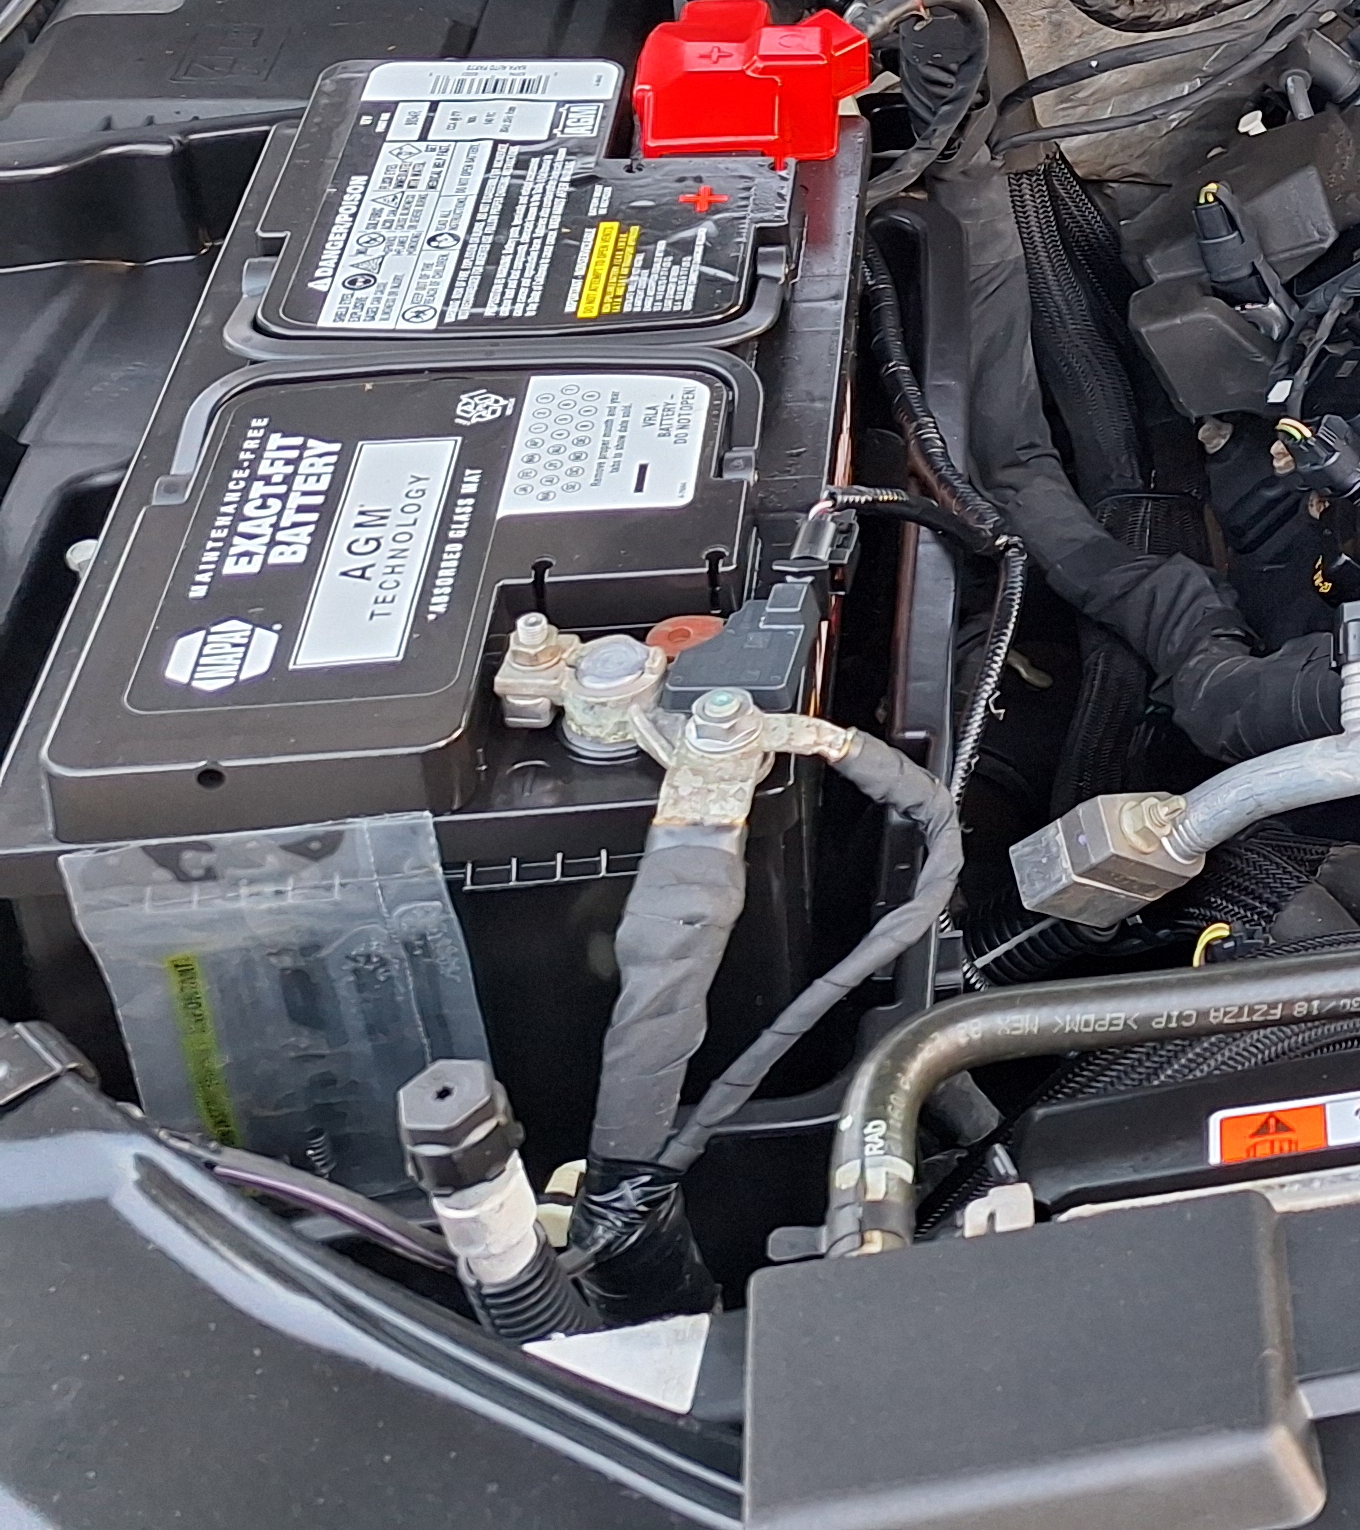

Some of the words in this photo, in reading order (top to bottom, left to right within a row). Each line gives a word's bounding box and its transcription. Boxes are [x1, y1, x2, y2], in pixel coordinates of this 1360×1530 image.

[562, 103, 598, 135] AGM
[315, 175, 368, 277] DANGER/POISON
[609, 391, 620, 404] year
[679, 386, 697, 411] OPEN!
[605, 406, 616, 417] and
[642, 405, 658, 427] VRLA
[657, 401, 675, 437] BATTERY
[676, 412, 691, 430] NOT
[602, 418, 615, 437] month
[617, 419, 630, 433] date
[673, 433, 688, 444] DO
[597, 439, 610, 460] proper
[614, 434, 627, 451] show
[590, 462, 605, 487] Remove
[609, 460, 619, 473] tabs
[460, 468, 483, 493] MAT
[188, 417, 268, 598] MAINTENANCE-FREE
[222, 433, 304, 575] EXACT-FIT
[268, 438, 342, 564] BATTERY
[447, 497, 476, 538] GLASS
[369, 473, 431, 620] TECHNOLOGY
[193, 630, 251, 679] NAPA
[1152, 1009, 1197, 1027] CIP
[863, 1118, 887, 1156] RAD
